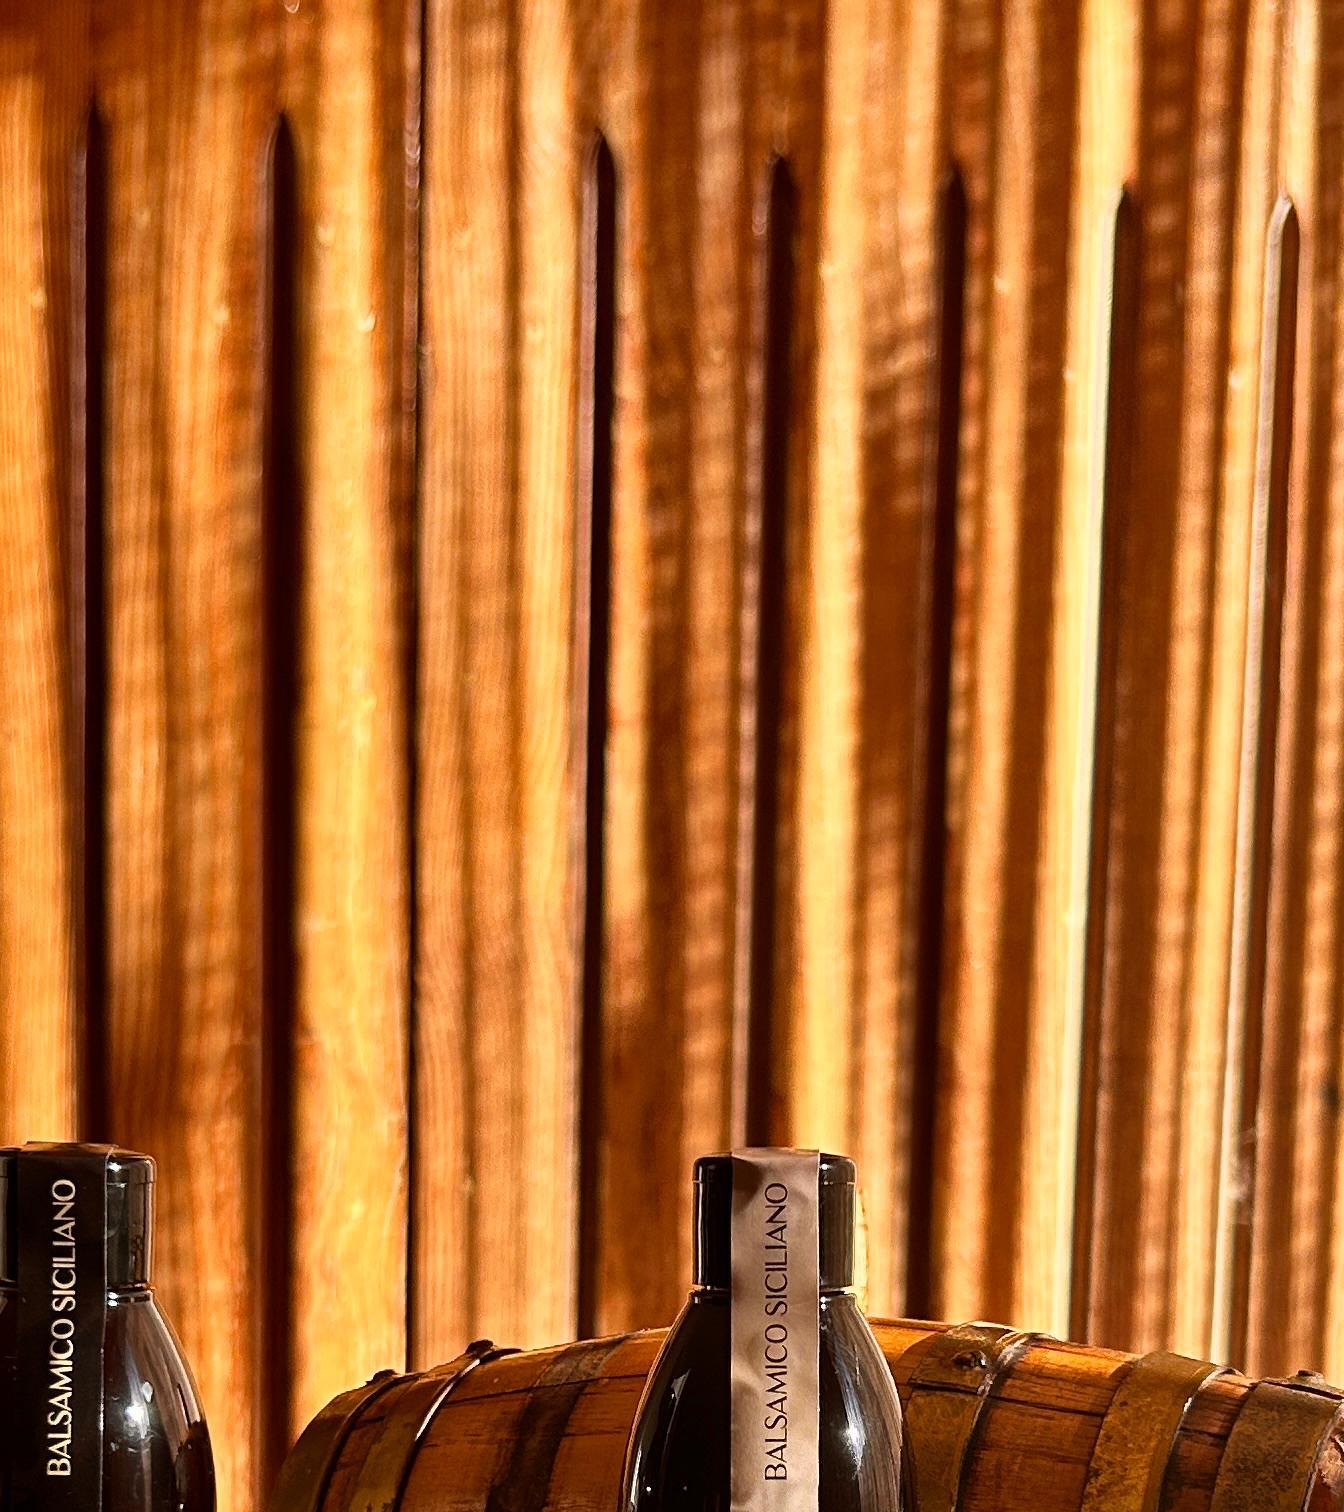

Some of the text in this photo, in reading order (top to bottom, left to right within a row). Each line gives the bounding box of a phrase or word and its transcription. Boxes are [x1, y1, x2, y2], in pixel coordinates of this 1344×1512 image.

[46, 1179, 76, 1476] BALSAMICO SICILIANO
[764, 1182, 788, 1480] BALSAMICO SICILIANO
